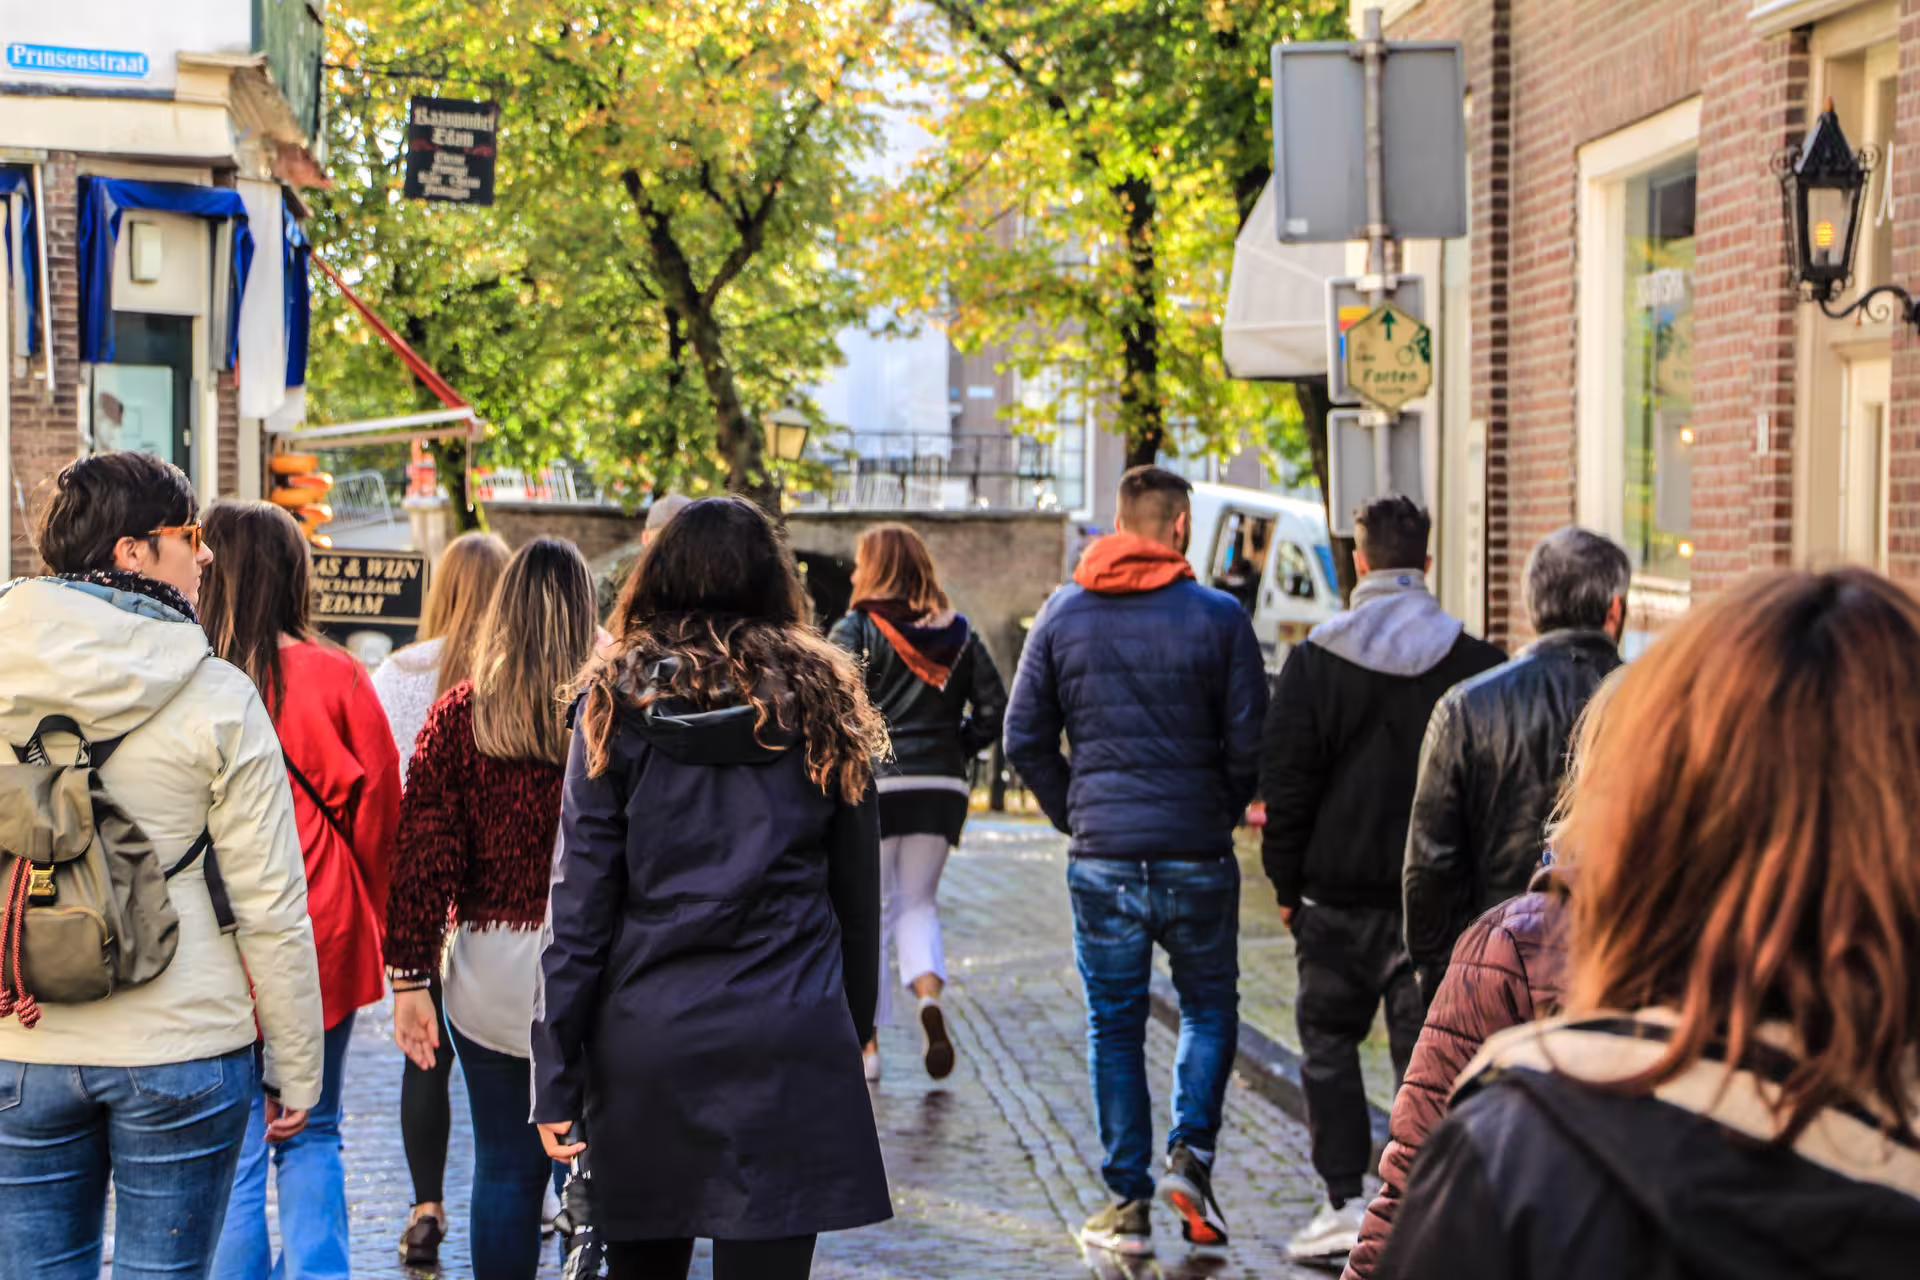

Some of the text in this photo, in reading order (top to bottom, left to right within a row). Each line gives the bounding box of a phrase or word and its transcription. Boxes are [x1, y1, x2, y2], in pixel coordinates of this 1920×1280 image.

[13, 45, 145, 73] Prinsenstraat
[344, 558, 360, 577] &
[319, 594, 384, 615] EDAM
